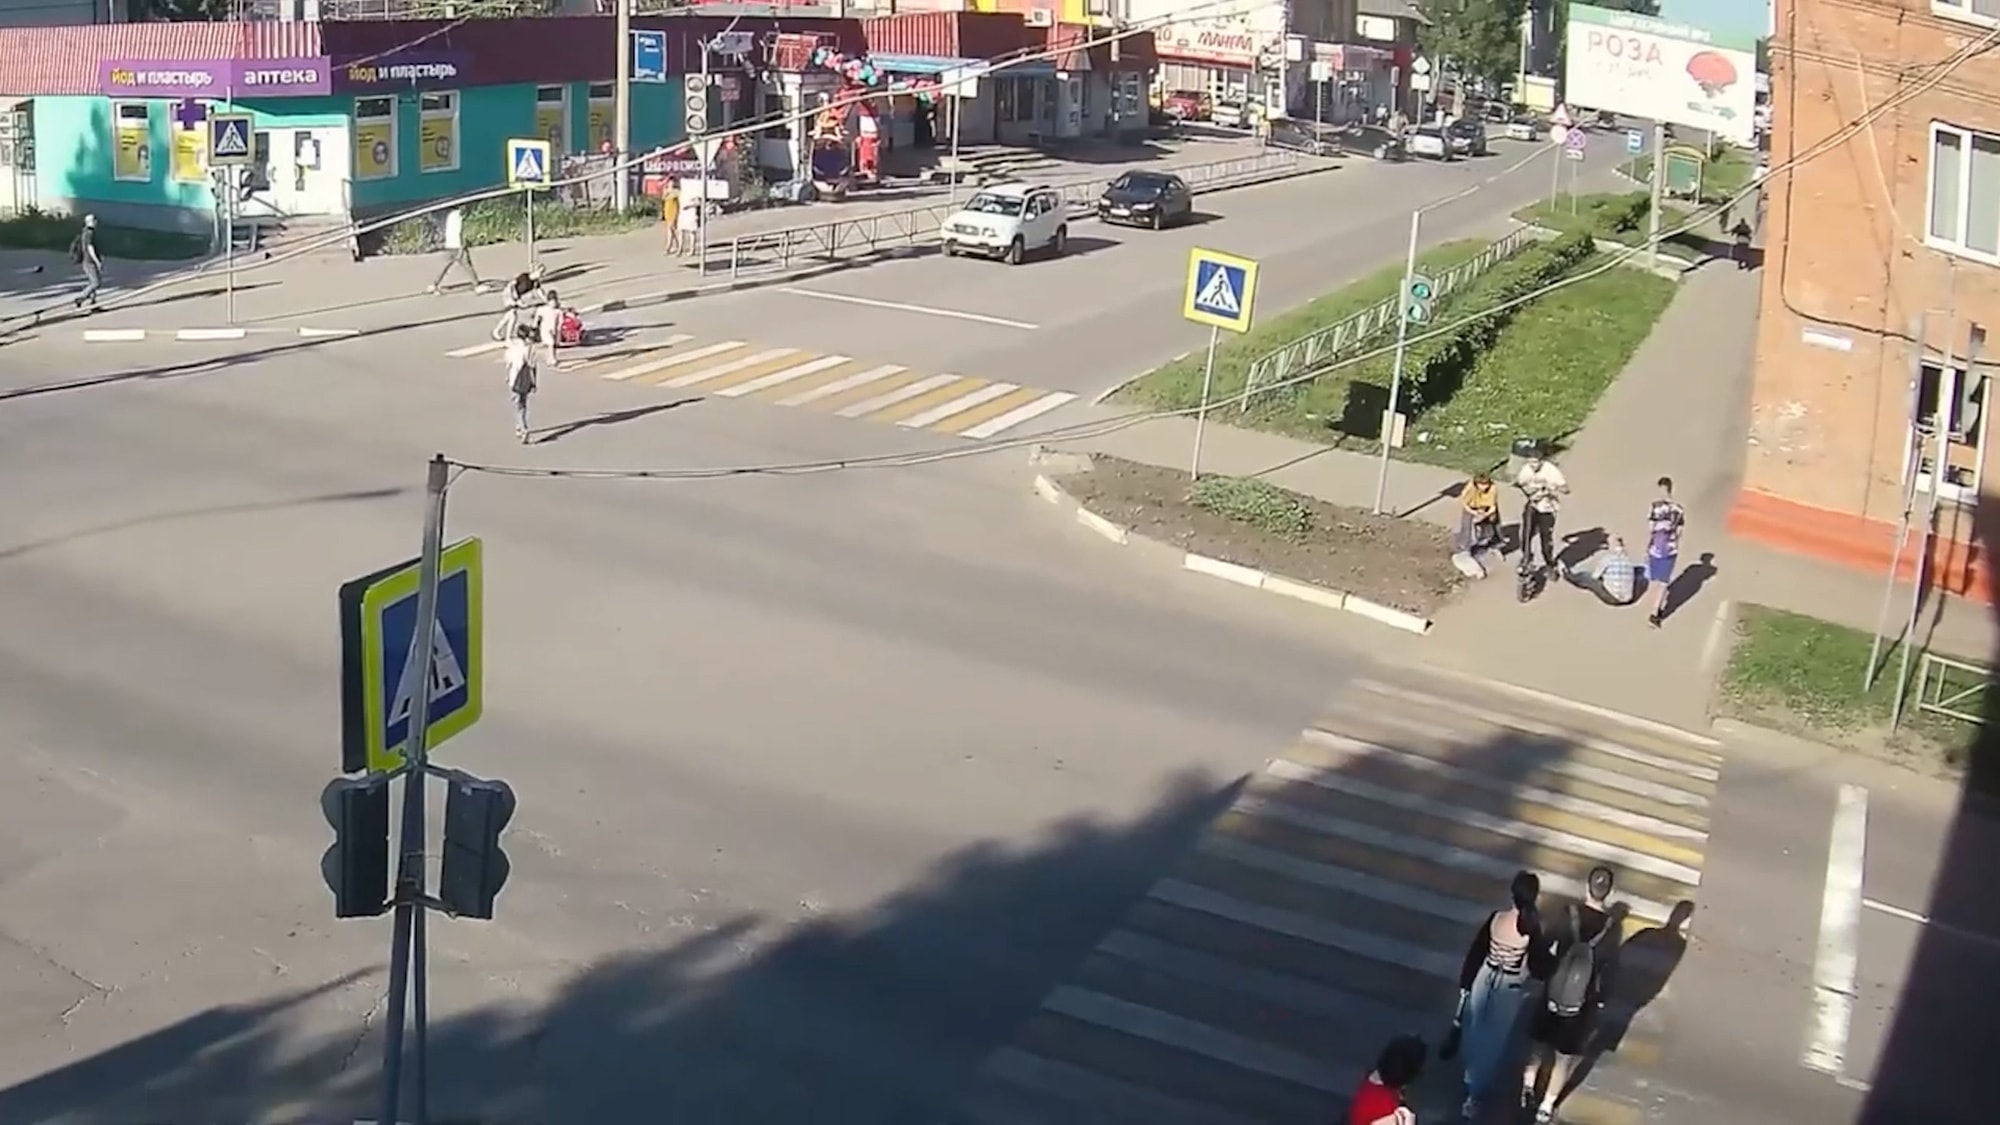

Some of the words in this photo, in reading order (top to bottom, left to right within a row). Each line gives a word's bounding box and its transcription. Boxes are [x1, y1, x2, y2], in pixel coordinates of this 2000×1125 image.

[1587, 30, 1663, 66] РОЗА
[111, 68, 136, 87] йод
[148, 69, 213, 87] пластырь
[244, 68, 317, 85] аптека
[378, 67, 389, 79] и
[390, 63, 457, 80] пластырь
